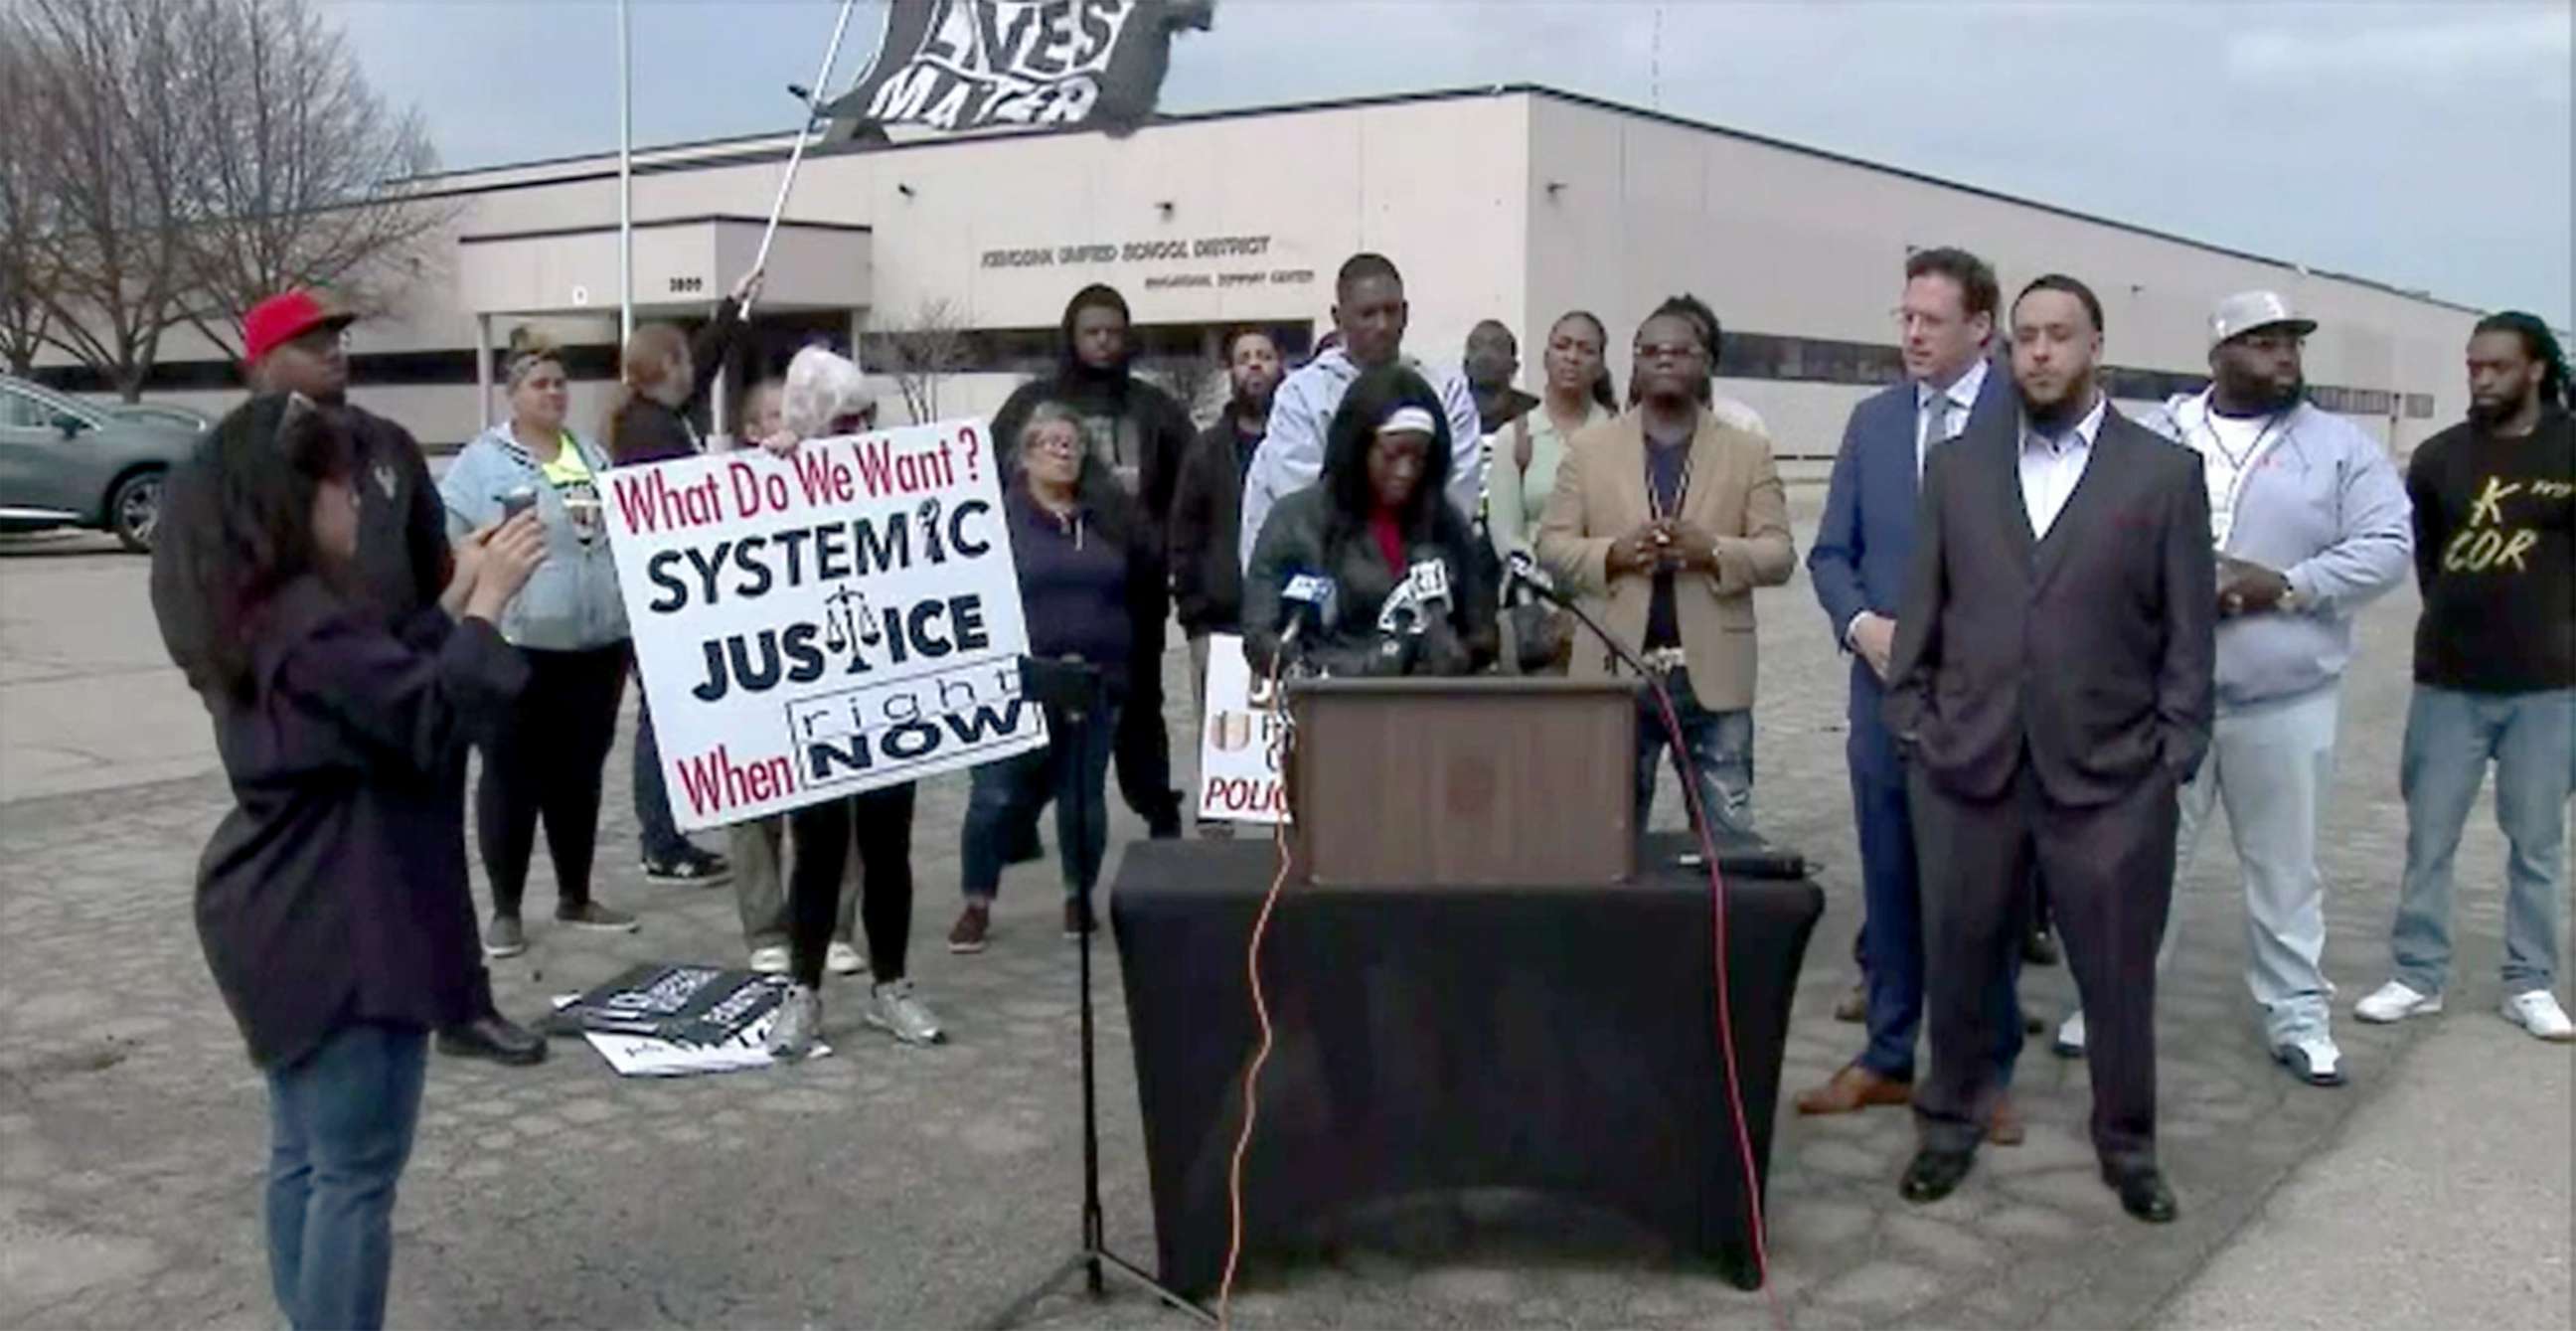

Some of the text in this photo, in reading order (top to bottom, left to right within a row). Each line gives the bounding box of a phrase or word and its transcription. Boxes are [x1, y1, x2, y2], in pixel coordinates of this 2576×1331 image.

[614, 469, 722, 535] What
[728, 461, 788, 519] Do
[792, 449, 854, 508] We
[852, 439, 954, 496] Want
[647, 496, 991, 614] SYSTEMIC
[692, 584, 990, 703] JUSTICE
[801, 670, 1022, 738] right
[811, 699, 1022, 778] NOW
[677, 744, 794, 815] When
